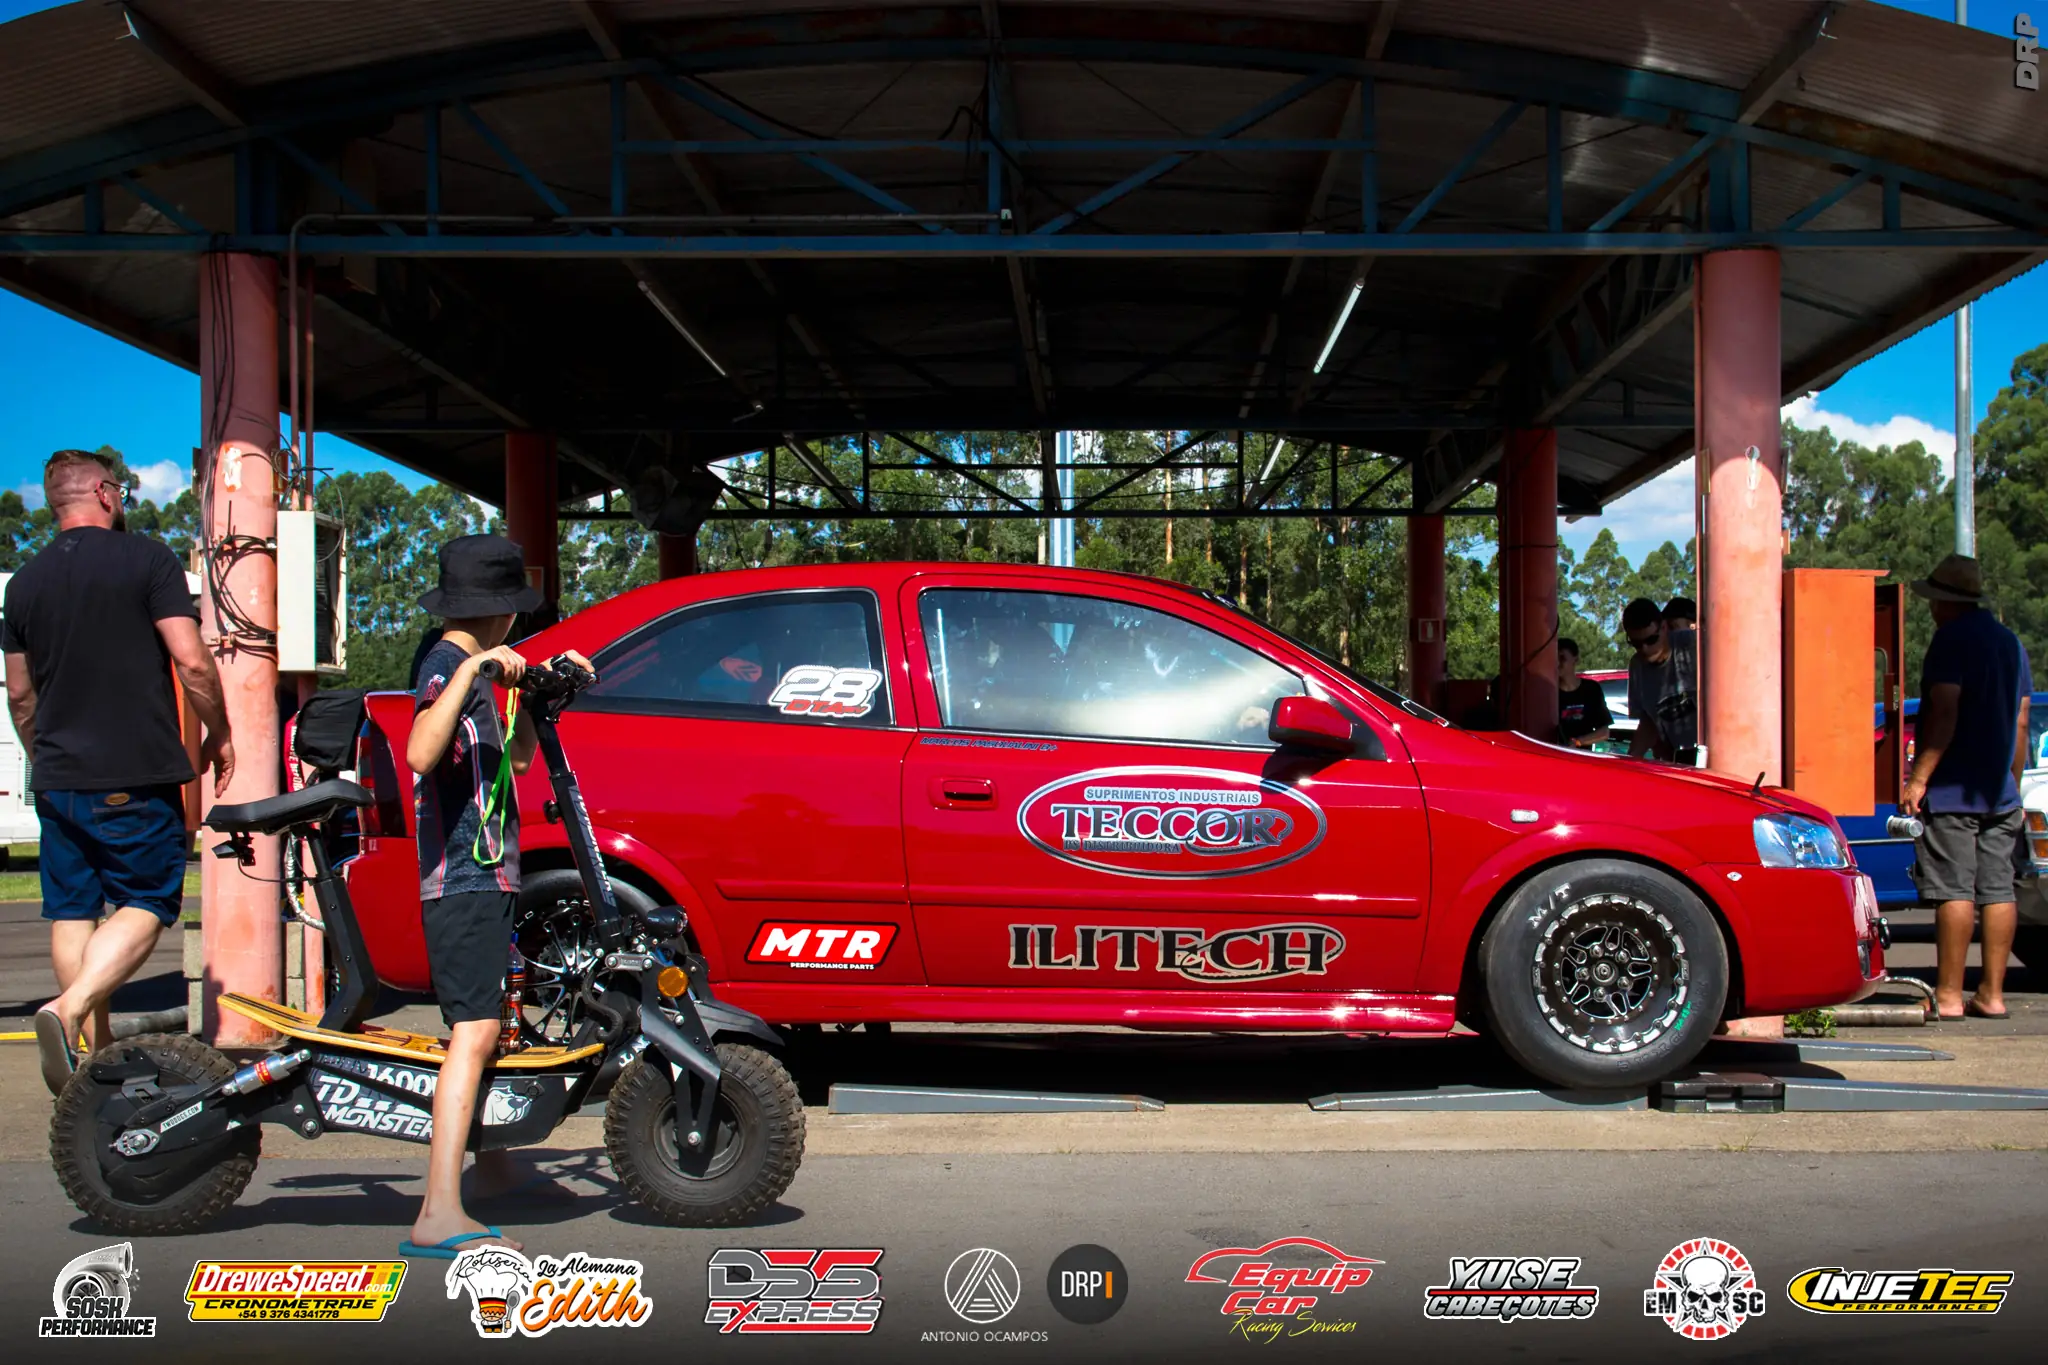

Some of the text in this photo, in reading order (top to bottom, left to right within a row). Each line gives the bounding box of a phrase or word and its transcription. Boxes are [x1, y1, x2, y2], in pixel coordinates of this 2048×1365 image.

[769, 666, 881, 706] 28
[920, 737, 971, 746] MARCOS
[1086, 788, 1260, 804] SUPRIMENTOS INDUSTRIAIS
[1051, 804, 1294, 848] TECCOR
[1527, 882, 1572, 929] M/T
[760, 928, 881, 959] MTR
[1009, 924, 1340, 980] ILITECH
[316, 1075, 361, 1105] TD
